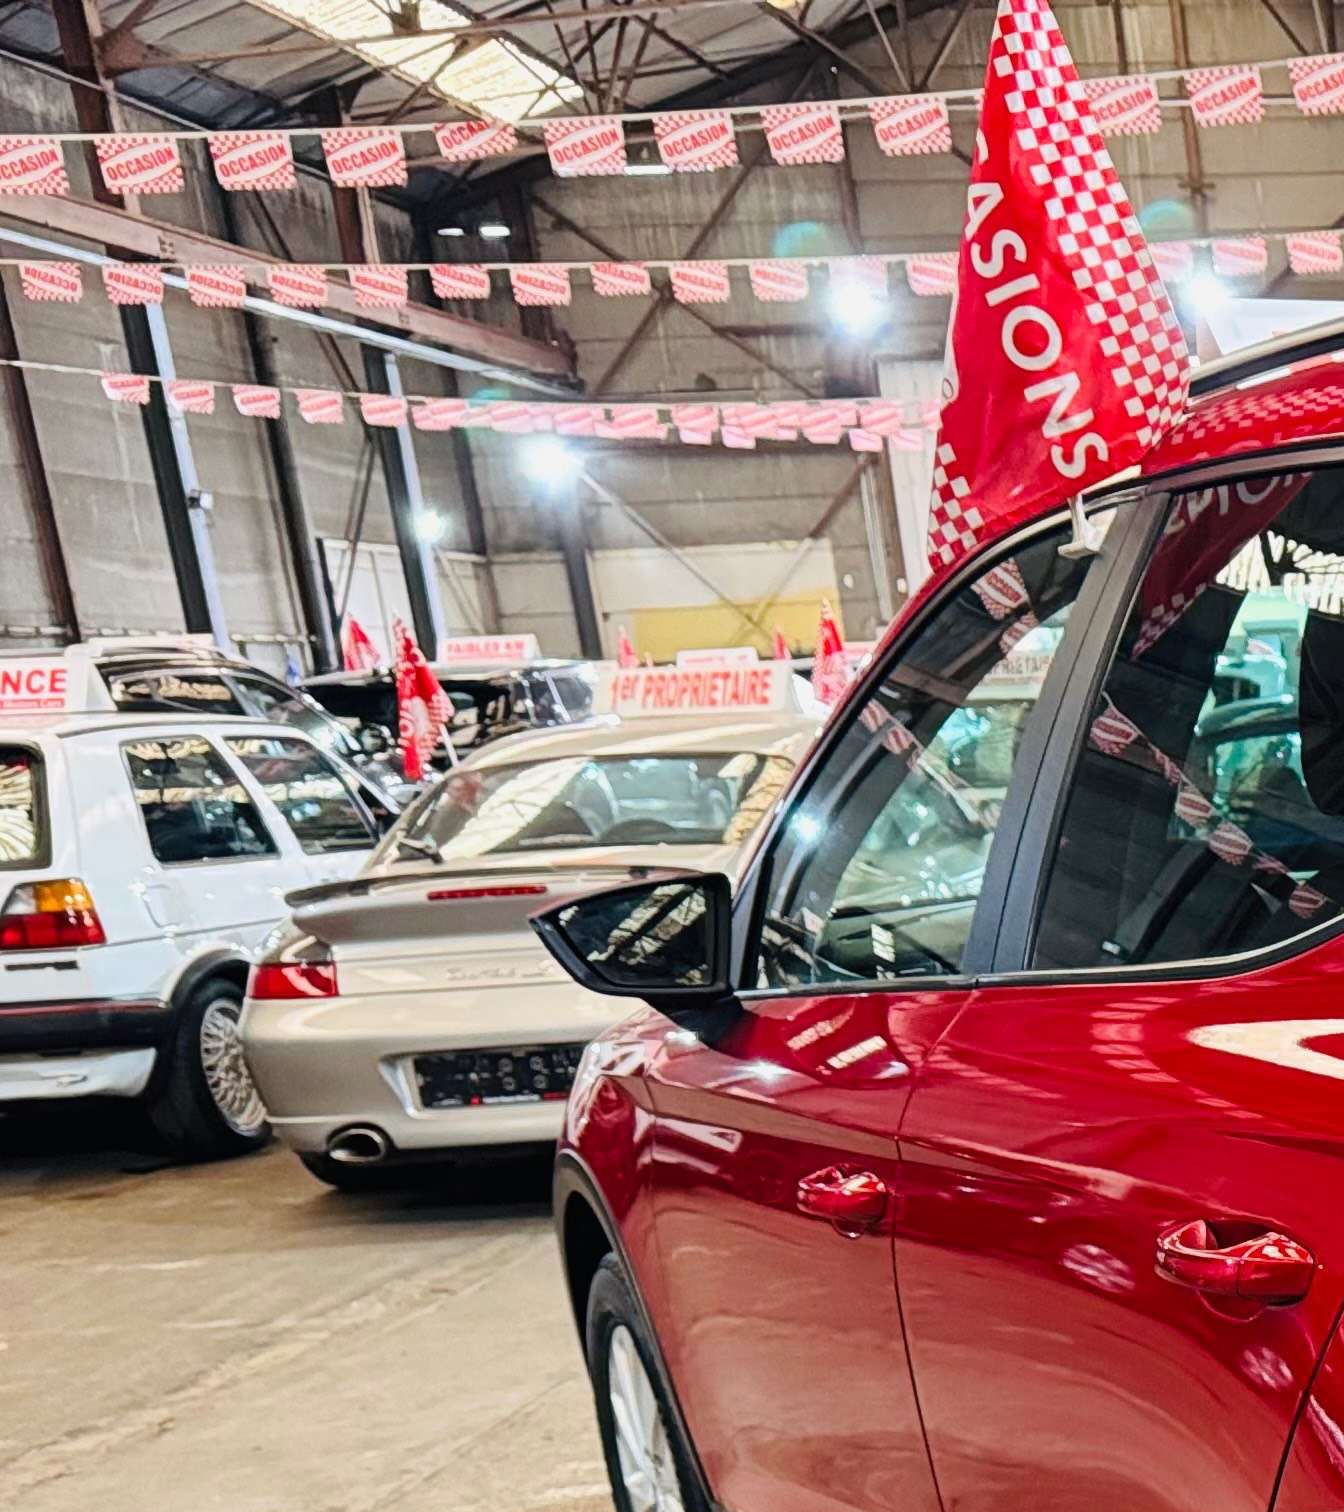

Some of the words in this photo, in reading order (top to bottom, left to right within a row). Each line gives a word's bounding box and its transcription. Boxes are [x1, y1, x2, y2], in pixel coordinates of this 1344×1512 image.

[1195, 77, 1257, 113] OCCASION
[663, 121, 729, 159] OCCASION
[771, 114, 836, 151] OCCASION
[879, 106, 942, 144] OCCASION
[0, 148, 59, 180] CCASION
[106, 146, 175, 182] OCCASION
[218, 143, 287, 179] OCCASION
[331, 138, 400, 174] OCCASION
[552, 127, 619, 166] OCCASION
[965, 131, 1109, 480] ASIONS
[642, 669, 771, 709] PROPRIETAIRE
